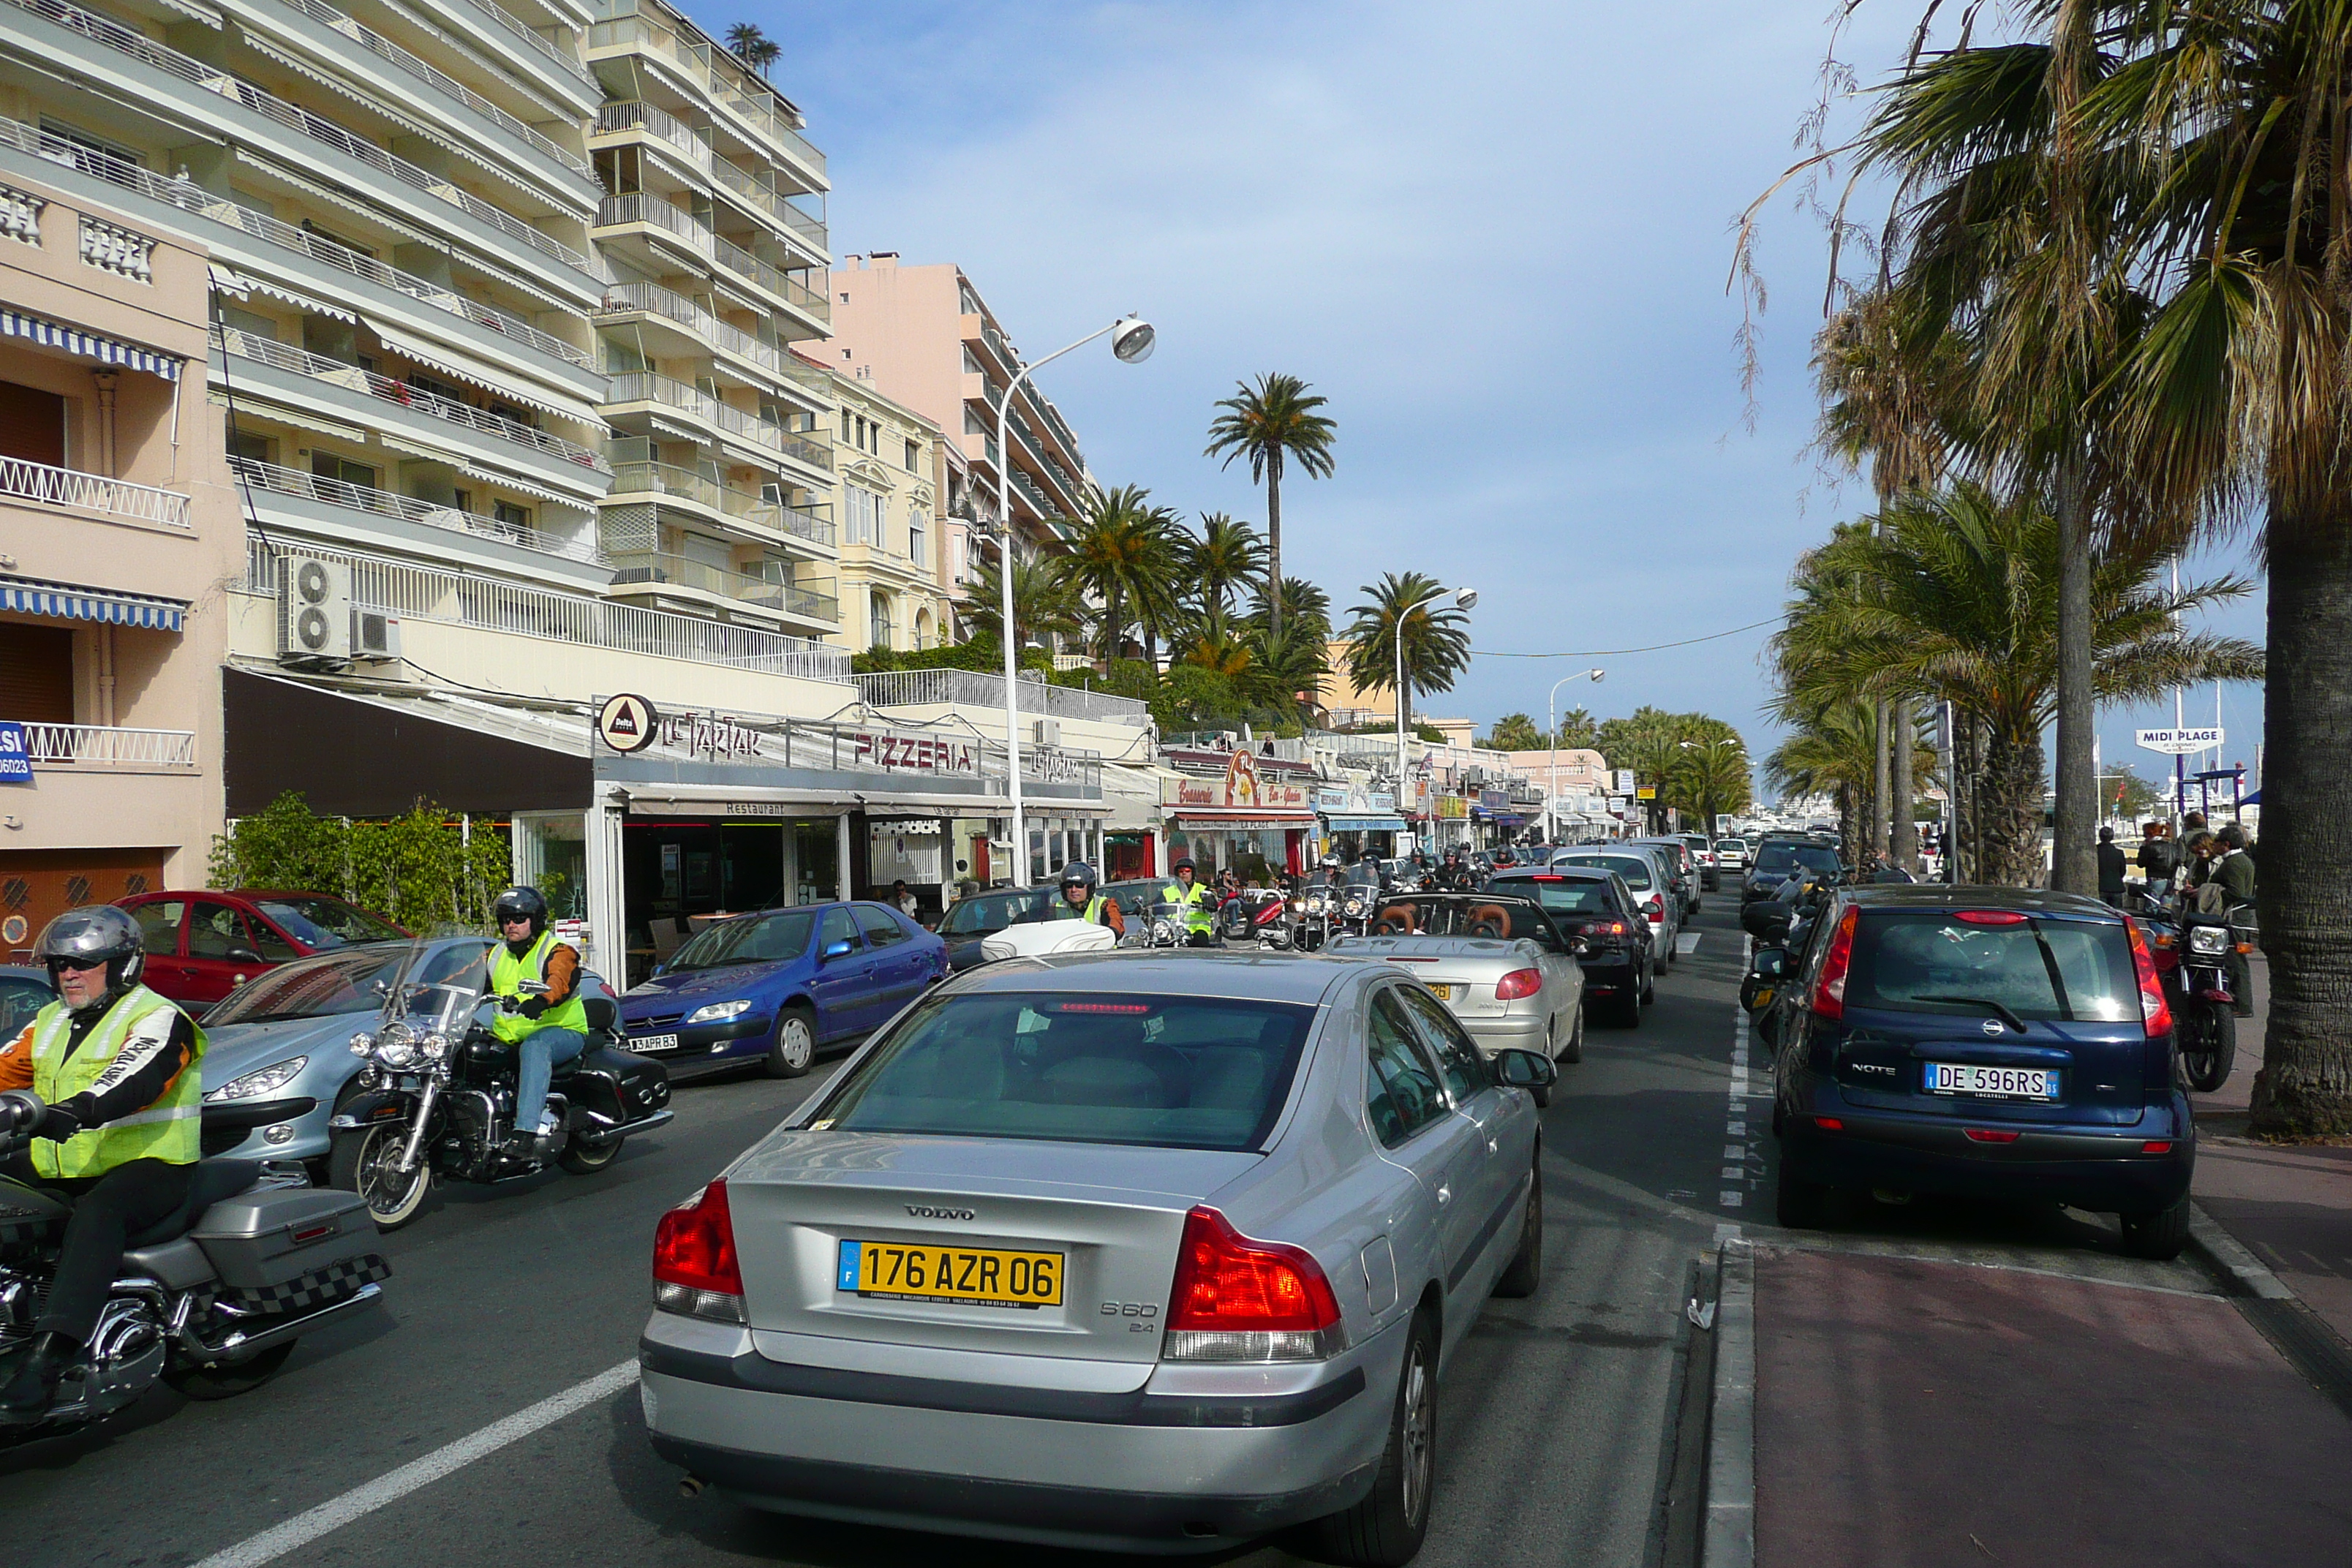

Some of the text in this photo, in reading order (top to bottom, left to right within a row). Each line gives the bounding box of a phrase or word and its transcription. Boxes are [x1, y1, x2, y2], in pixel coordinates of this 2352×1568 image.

[615, 717, 633, 727] Delta
[663, 712, 764, 760] LE TARTAR
[2144, 731, 2217, 742] MIDI PLAGE
[855, 734, 972, 771] PIZZERIA
[726, 802, 784, 815] Restaurant
[645, 1037, 661, 1049] APR
[663, 1036, 676, 1047] 83
[1852, 1063, 1896, 1076] NOTE
[1940, 1067, 1966, 1089] DE
[1975, 1069, 2043, 1093] 596RS
[905, 1205, 975, 1221] VOLVO
[845, 1248, 1054, 1296] F 176 AZR 06
